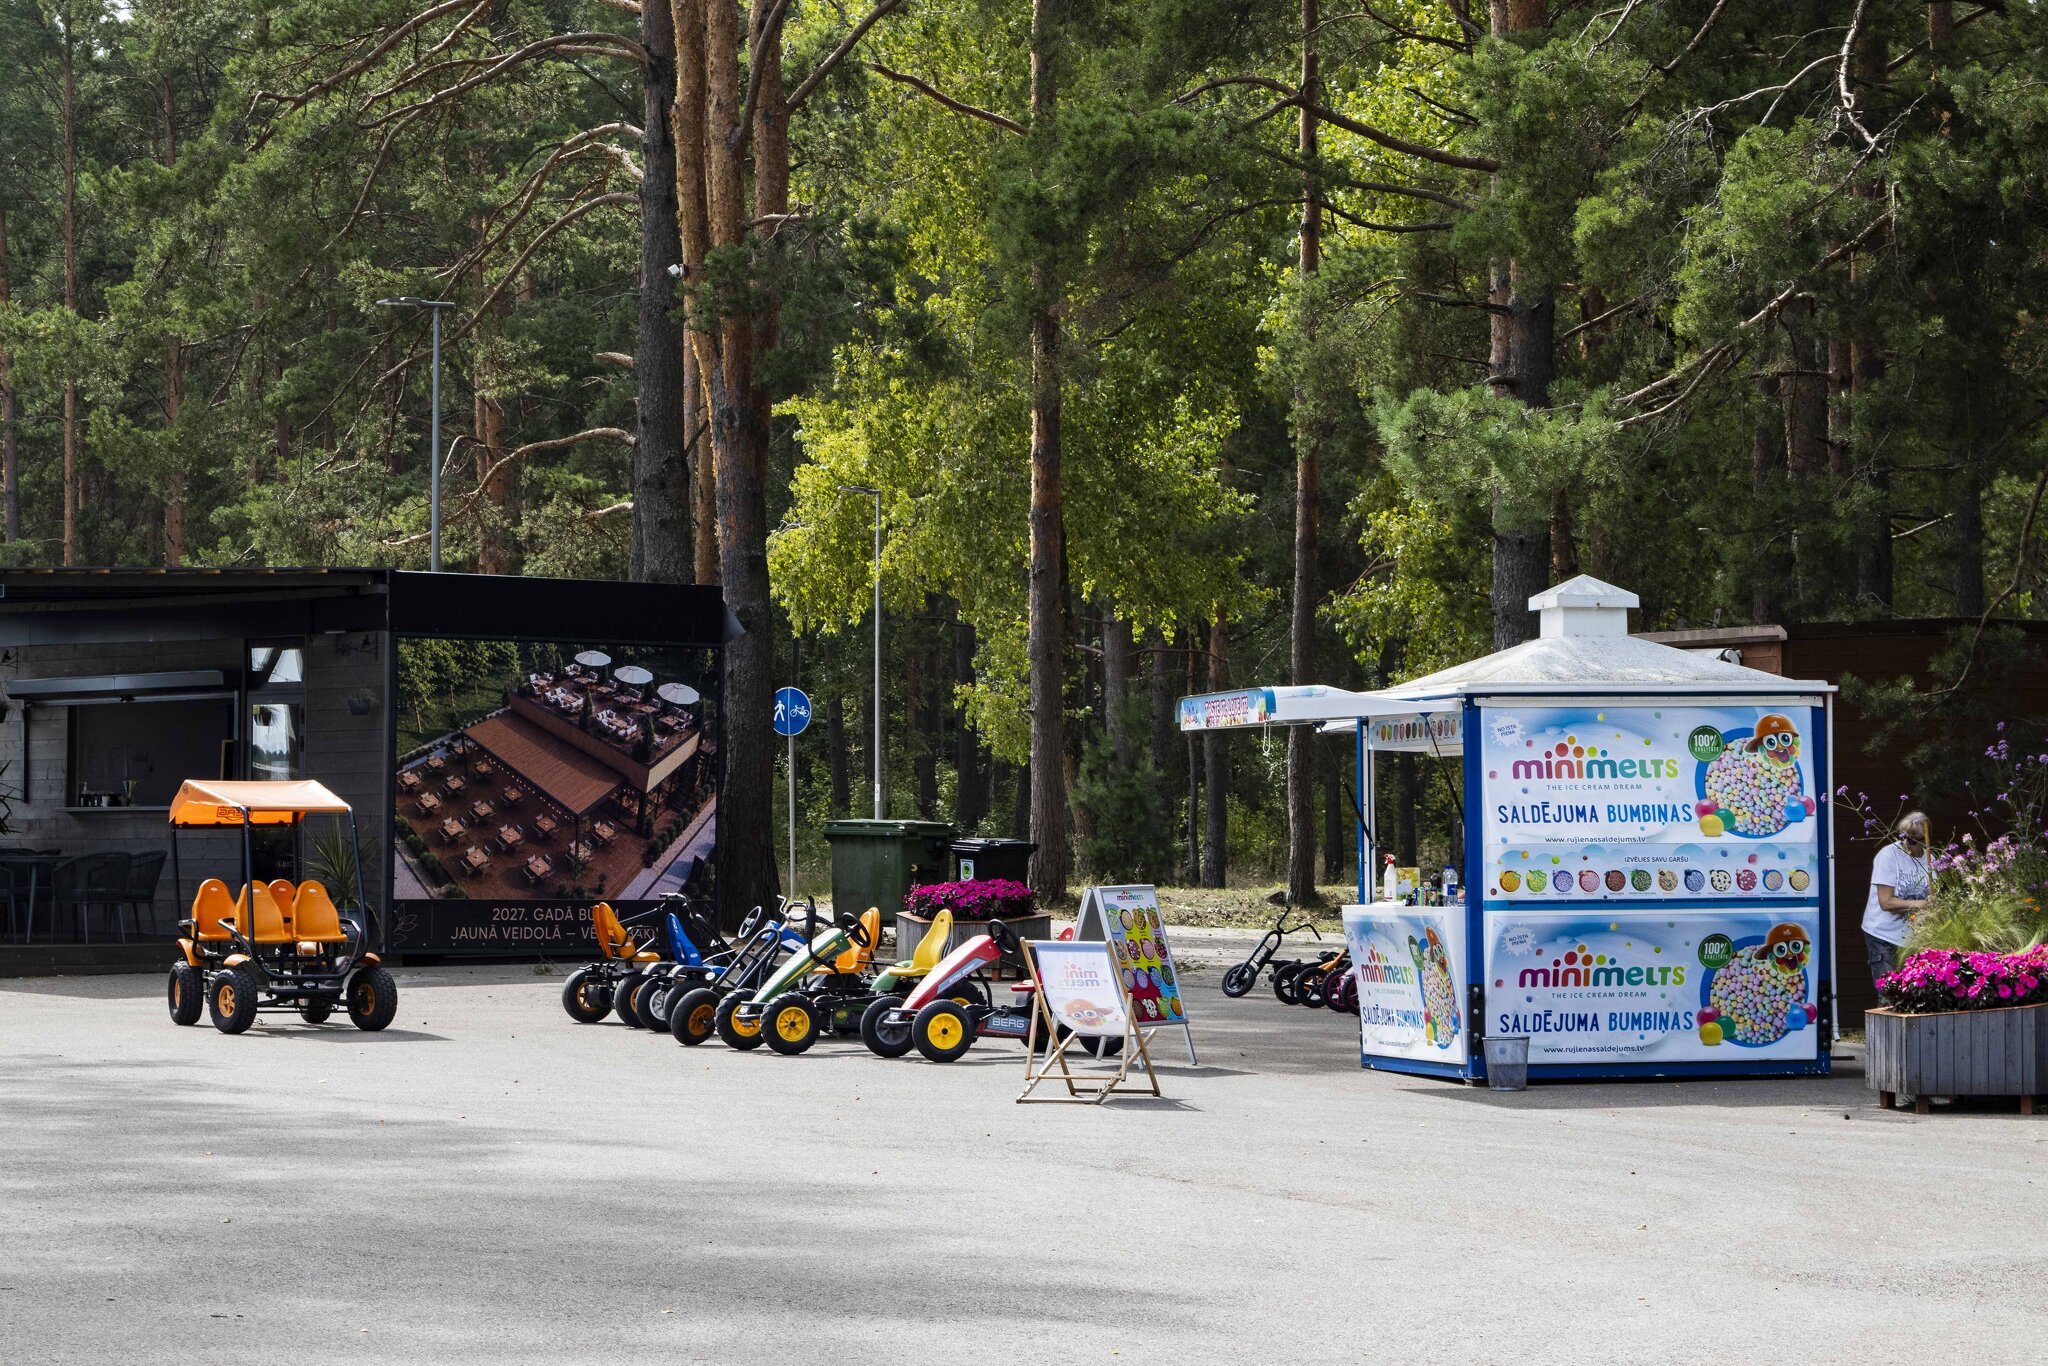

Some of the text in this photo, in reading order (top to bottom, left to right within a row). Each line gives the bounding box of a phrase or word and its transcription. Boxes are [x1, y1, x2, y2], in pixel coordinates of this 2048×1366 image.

[1498, 801, 1693, 826] SALDĒJUMA BUMBIŅAS
[1544, 836, 1646, 844] www.rujienassaldejums.lv
[1624, 855, 1651, 863] IZVĒLIES
[1668, 855, 1689, 863] GARŠU
[492, 908, 528, 921] 2027.
[533, 906, 574, 921] GADĀ
[451, 925, 498, 940] JAUNĀ
[502, 925, 562, 940] VEIDOLĀ
[992, 1017, 1025, 1028] BERG
[1500, 1010, 1694, 1034] SALDĒJUMA BUMBIŅAS
[1543, 1045, 1646, 1054] www.rujienassaldejums.lv
